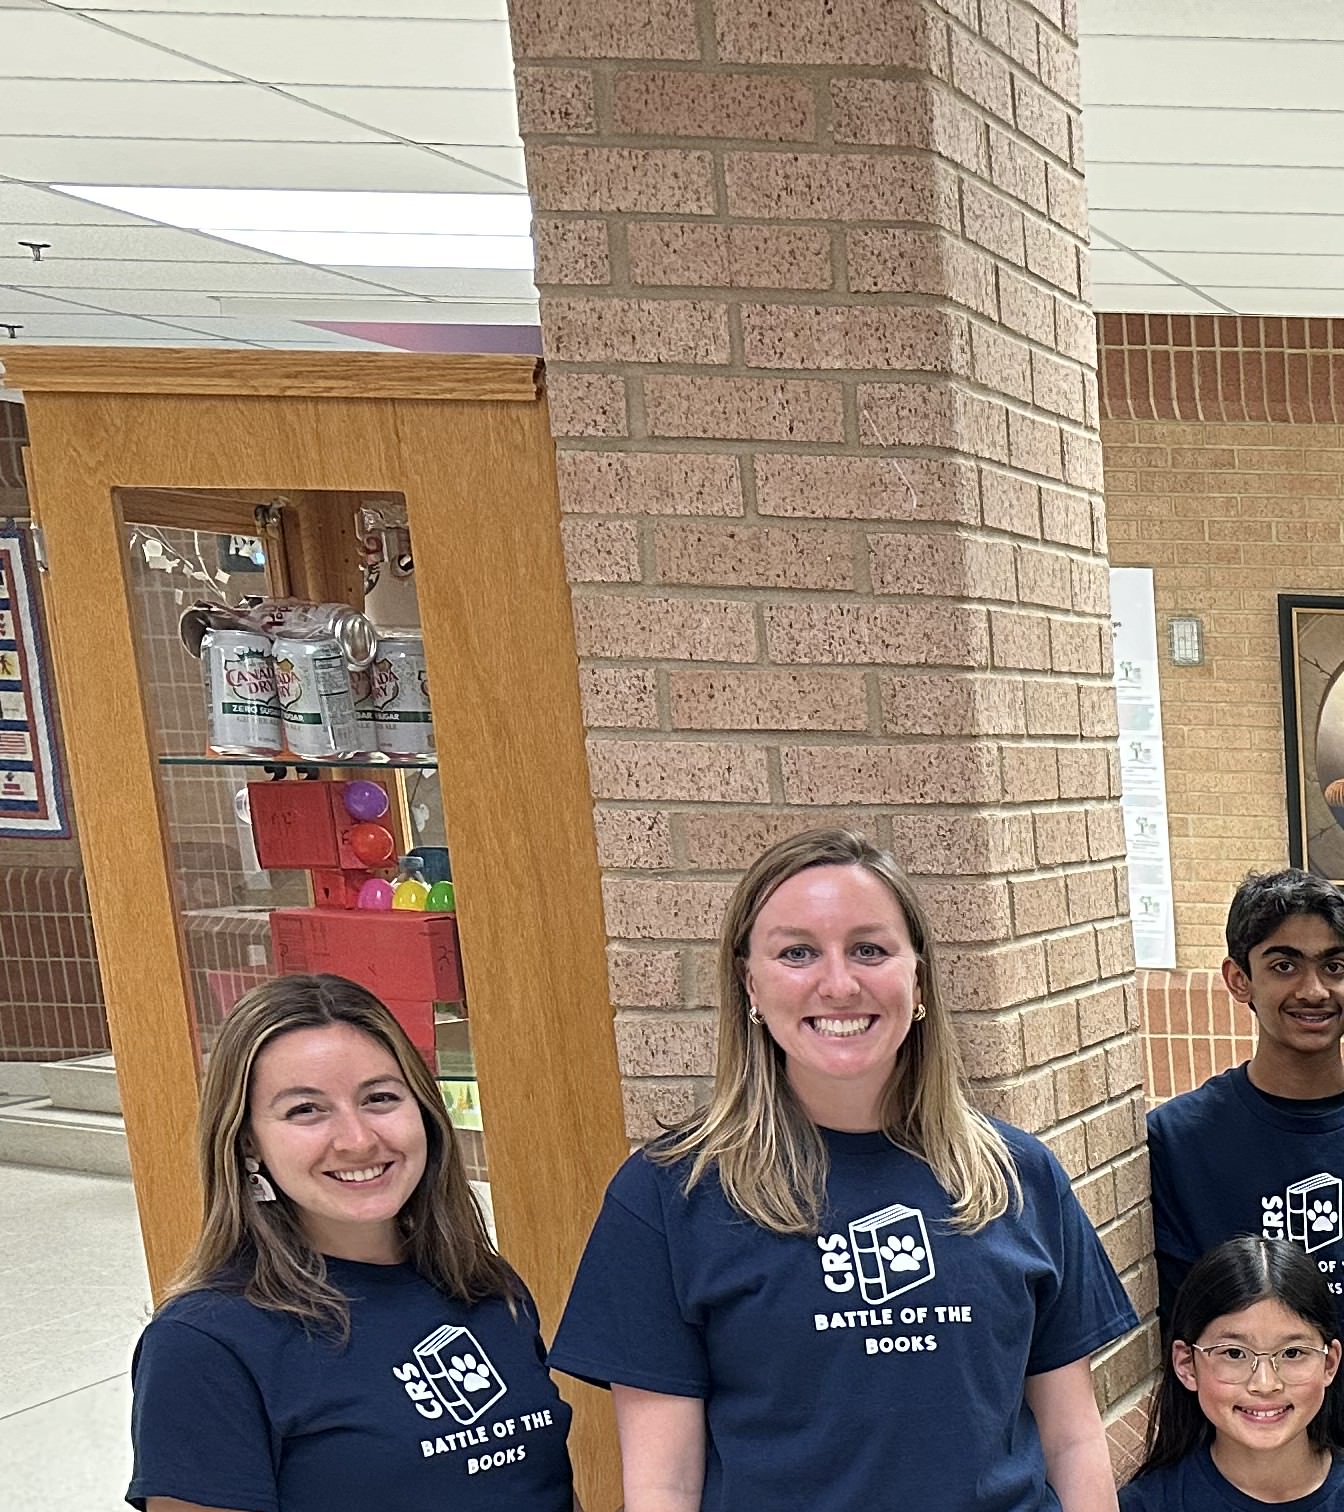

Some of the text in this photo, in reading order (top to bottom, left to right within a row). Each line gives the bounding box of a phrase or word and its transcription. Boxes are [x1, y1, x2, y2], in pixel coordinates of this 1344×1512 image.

[226, 667, 275, 687] CANAD
[247, 681, 275, 694] DRY
[232, 705, 257, 715] ZERO
[817, 1233, 854, 1293] CRS
[1318, 1261, 1336, 1273] OF
[814, 1306, 972, 1331] BATTLE OF THE
[865, 1335, 937, 1355] BOOKS
[392, 1362, 443, 1419] CRS
[421, 1410, 553, 1458] BATTLE OF THE
[468, 1445, 526, 1475] BOOKS
